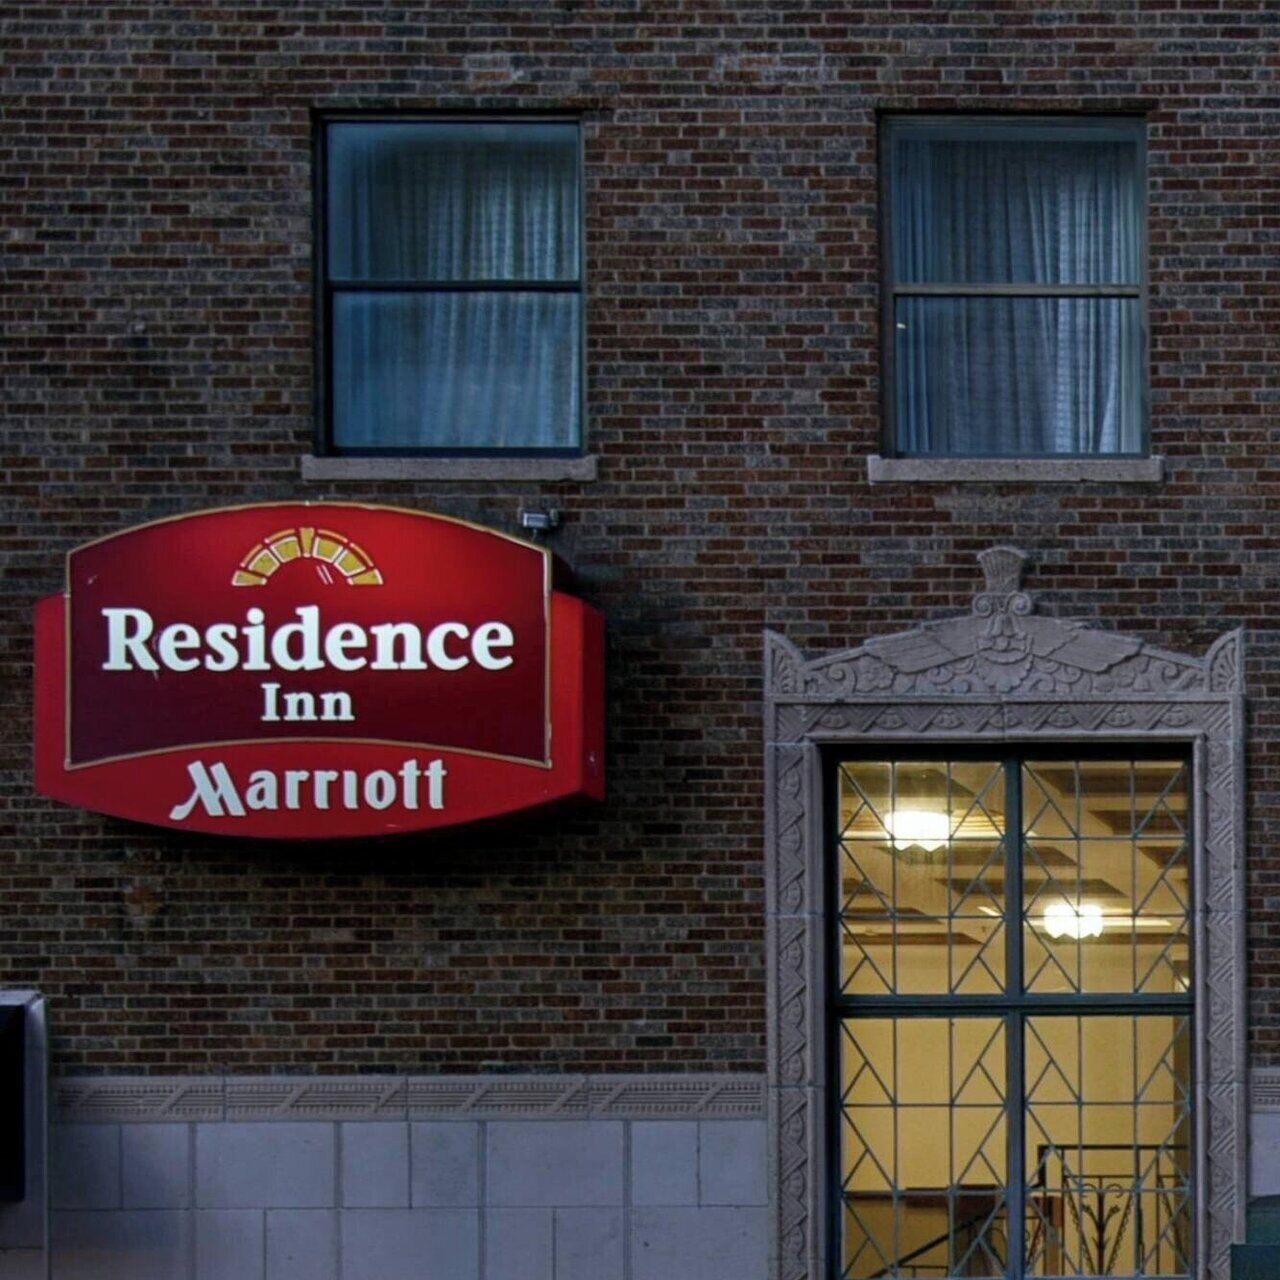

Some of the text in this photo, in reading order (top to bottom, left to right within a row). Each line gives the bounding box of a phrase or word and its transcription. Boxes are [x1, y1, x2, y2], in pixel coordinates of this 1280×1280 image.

[102, 605, 514, 672] Residence
[261, 683, 355, 721] Inn
[169, 759, 447, 820] Marriott
